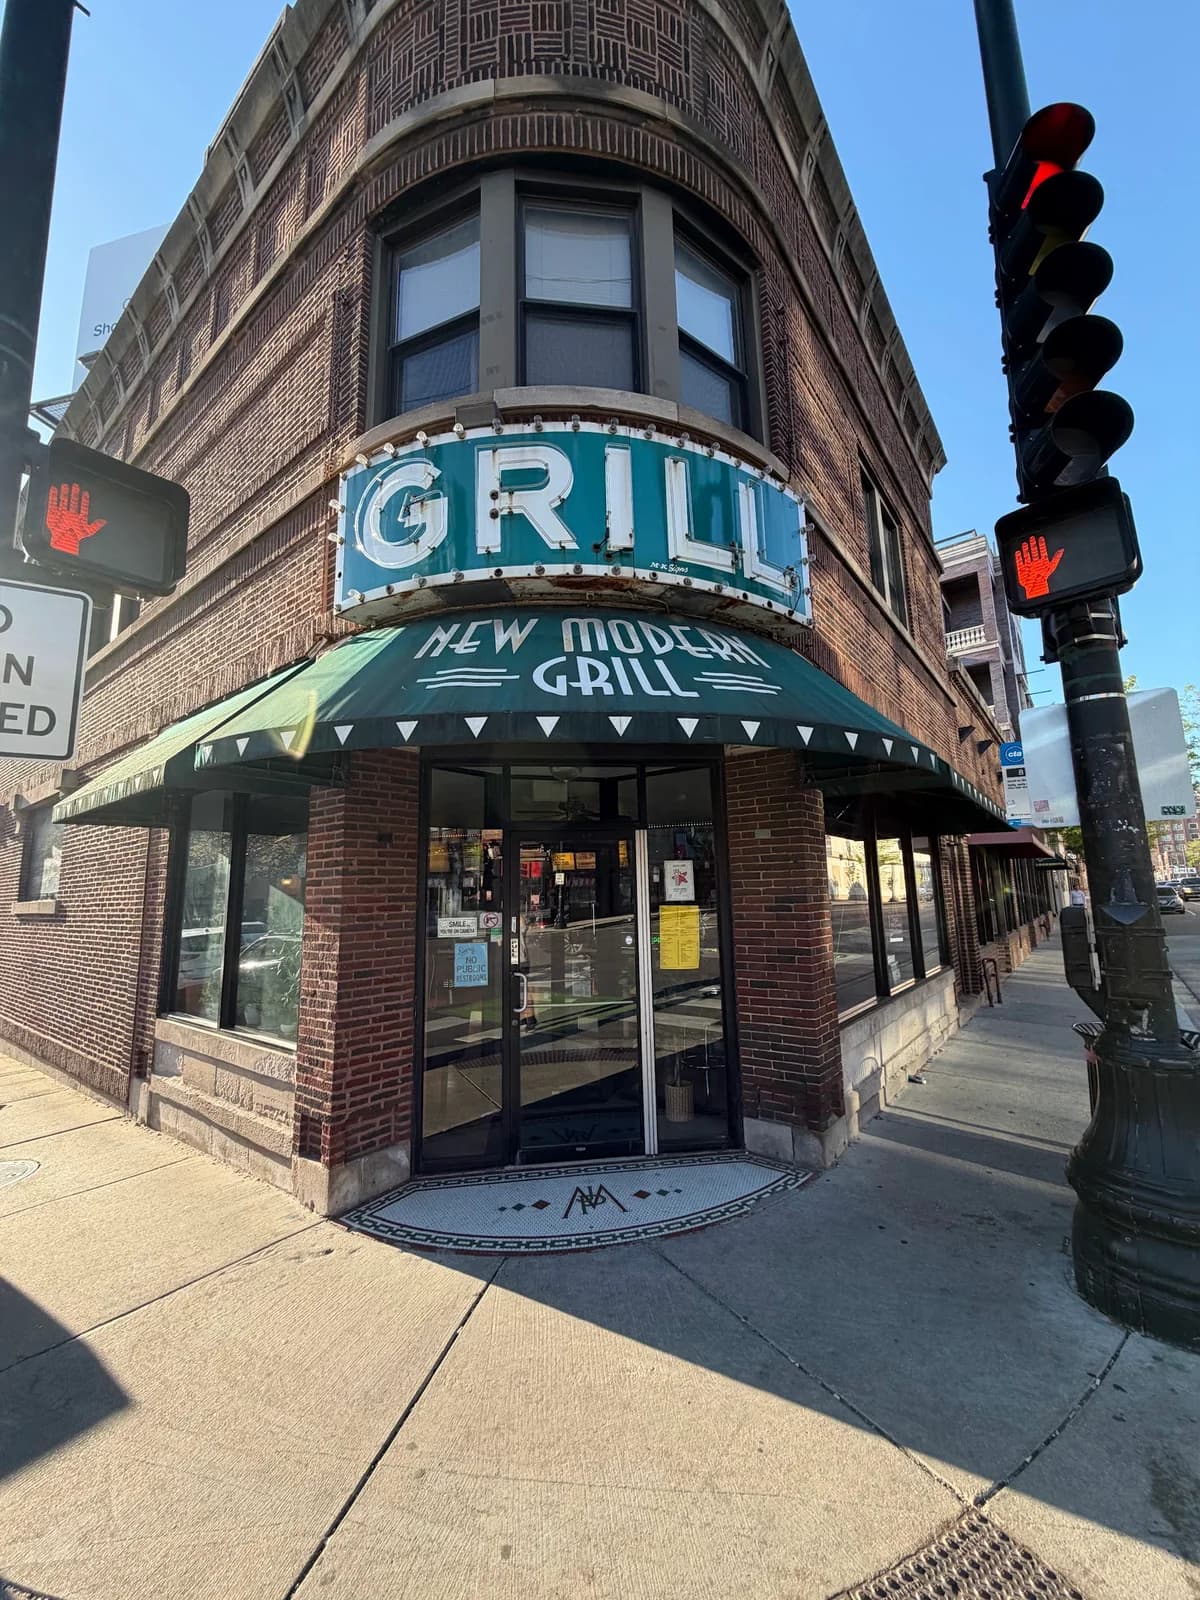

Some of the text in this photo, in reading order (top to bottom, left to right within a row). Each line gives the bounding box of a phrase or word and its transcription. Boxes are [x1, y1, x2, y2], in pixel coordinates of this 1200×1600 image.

[354, 442, 798, 596] GRILL
[413, 617, 772, 669] NEW MODERN
[532, 655, 700, 698] GRILL
[456, 964, 487, 973] PUBLIC
[465, 956, 478, 964] NO
